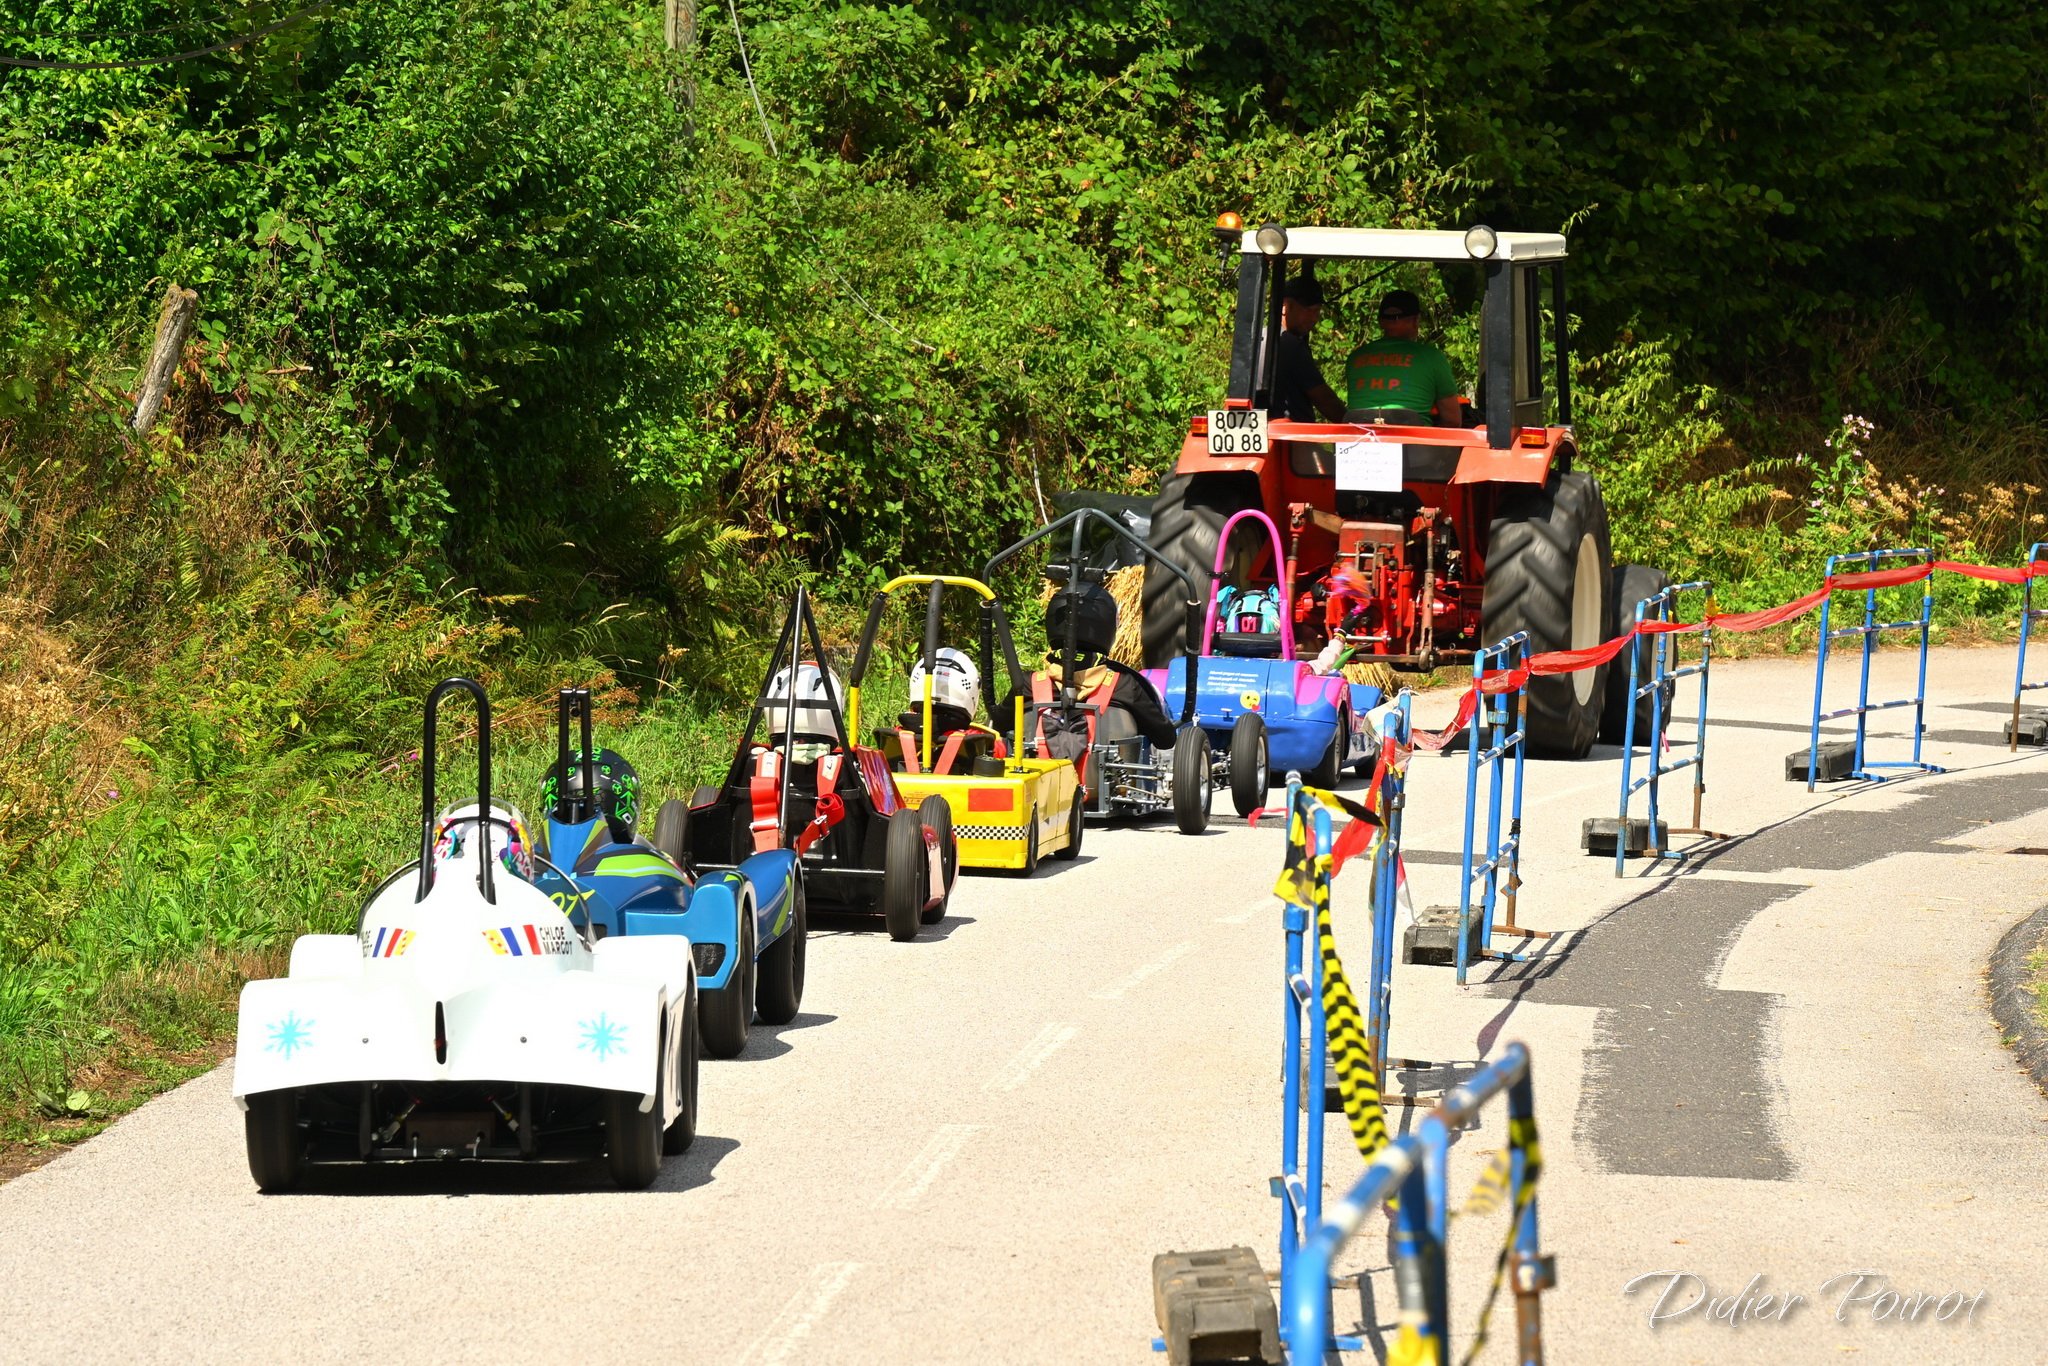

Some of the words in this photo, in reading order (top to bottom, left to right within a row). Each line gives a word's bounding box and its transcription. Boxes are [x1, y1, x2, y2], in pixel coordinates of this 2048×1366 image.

[1215, 411, 1259, 430] 8073
[1213, 434, 1234, 452] QQ
[1241, 434, 1262, 452] 88
[539, 926, 565, 941] CHLOE
